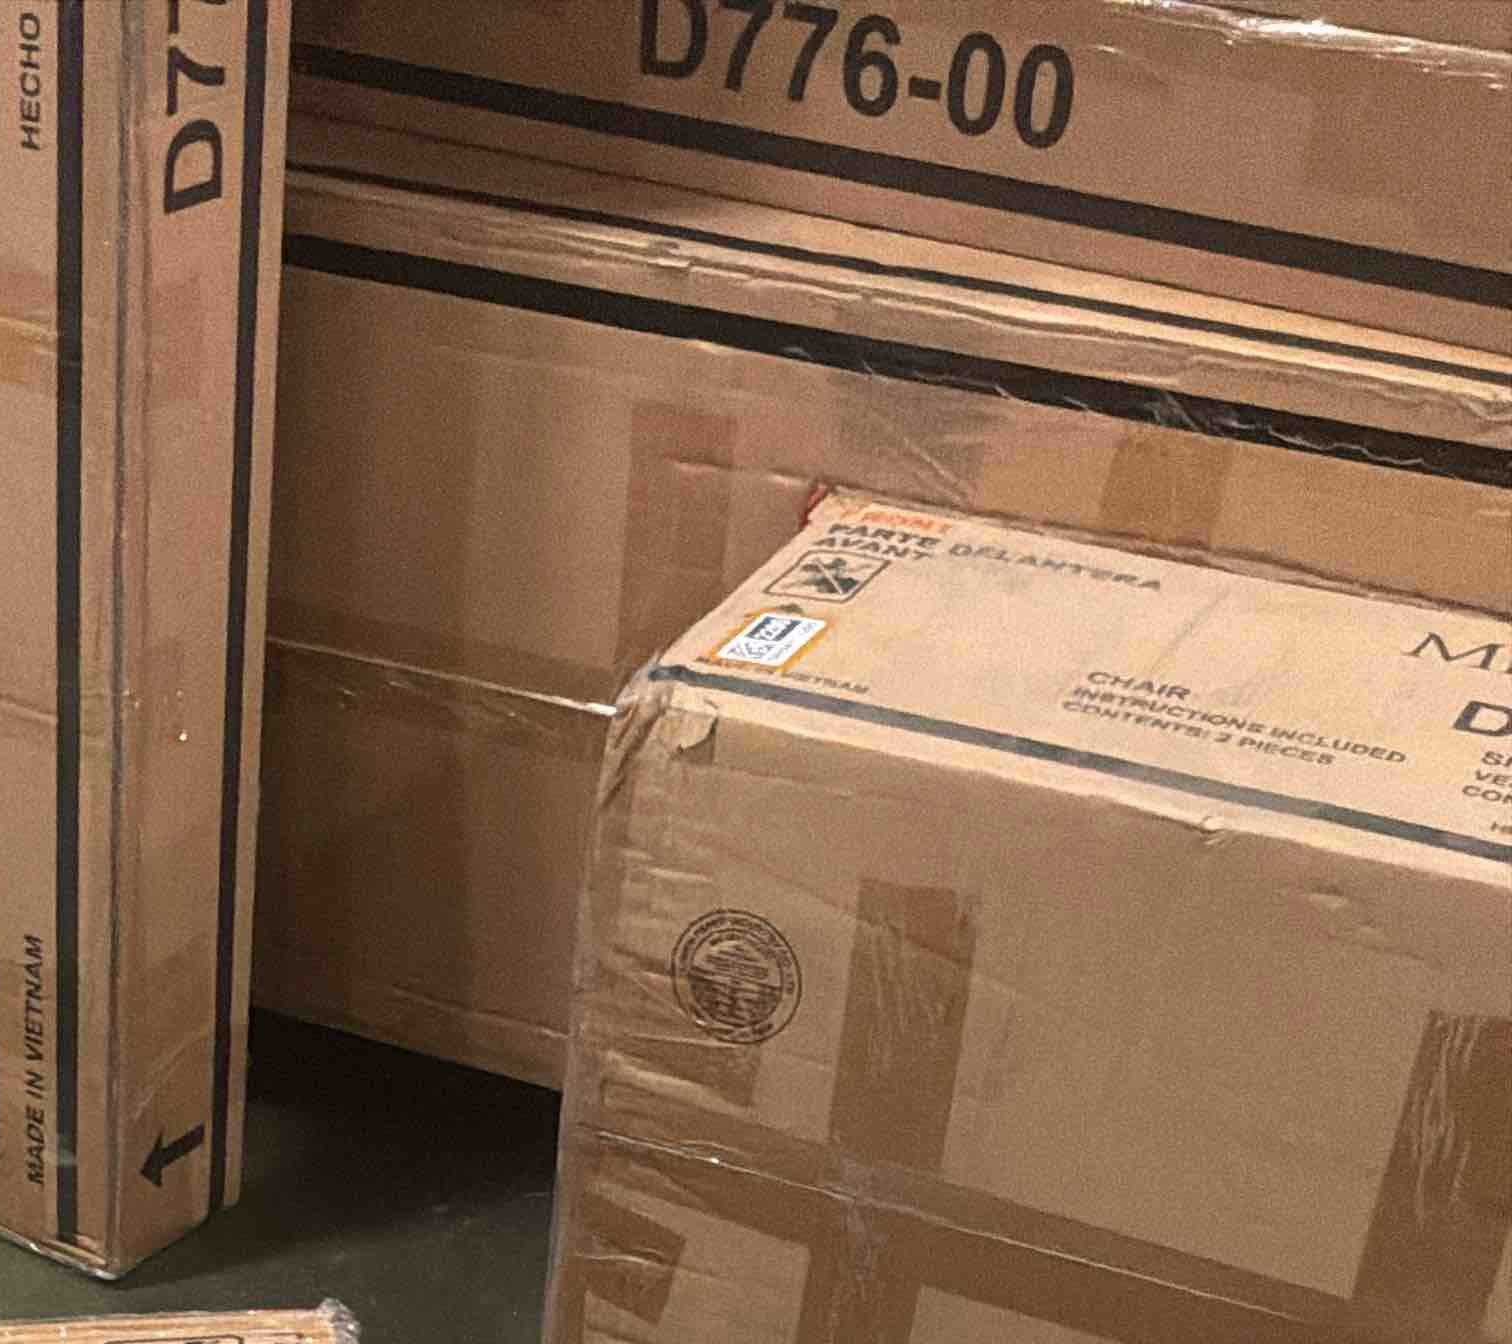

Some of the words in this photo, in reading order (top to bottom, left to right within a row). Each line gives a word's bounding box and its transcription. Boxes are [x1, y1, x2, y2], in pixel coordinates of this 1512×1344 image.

[19, 12, 42, 151] HECHO
[638, 0, 1075, 149] D776-00
[812, 537, 935, 560] AVANT
[827, 522, 940, 549] PARTE
[946, 543, 1162, 591] DELANTERA
[1088, 670, 1192, 701] CHAIR
[1073, 686, 1265, 734] INSTRUCTIONS
[1271, 726, 1408, 764] INCLUDED
[1238, 737, 1337, 766] PIECES
[24, 935, 44, 1066] VIETNAM
[26, 1072, 44, 1102] IN
[26, 1108, 46, 1186] MADE
